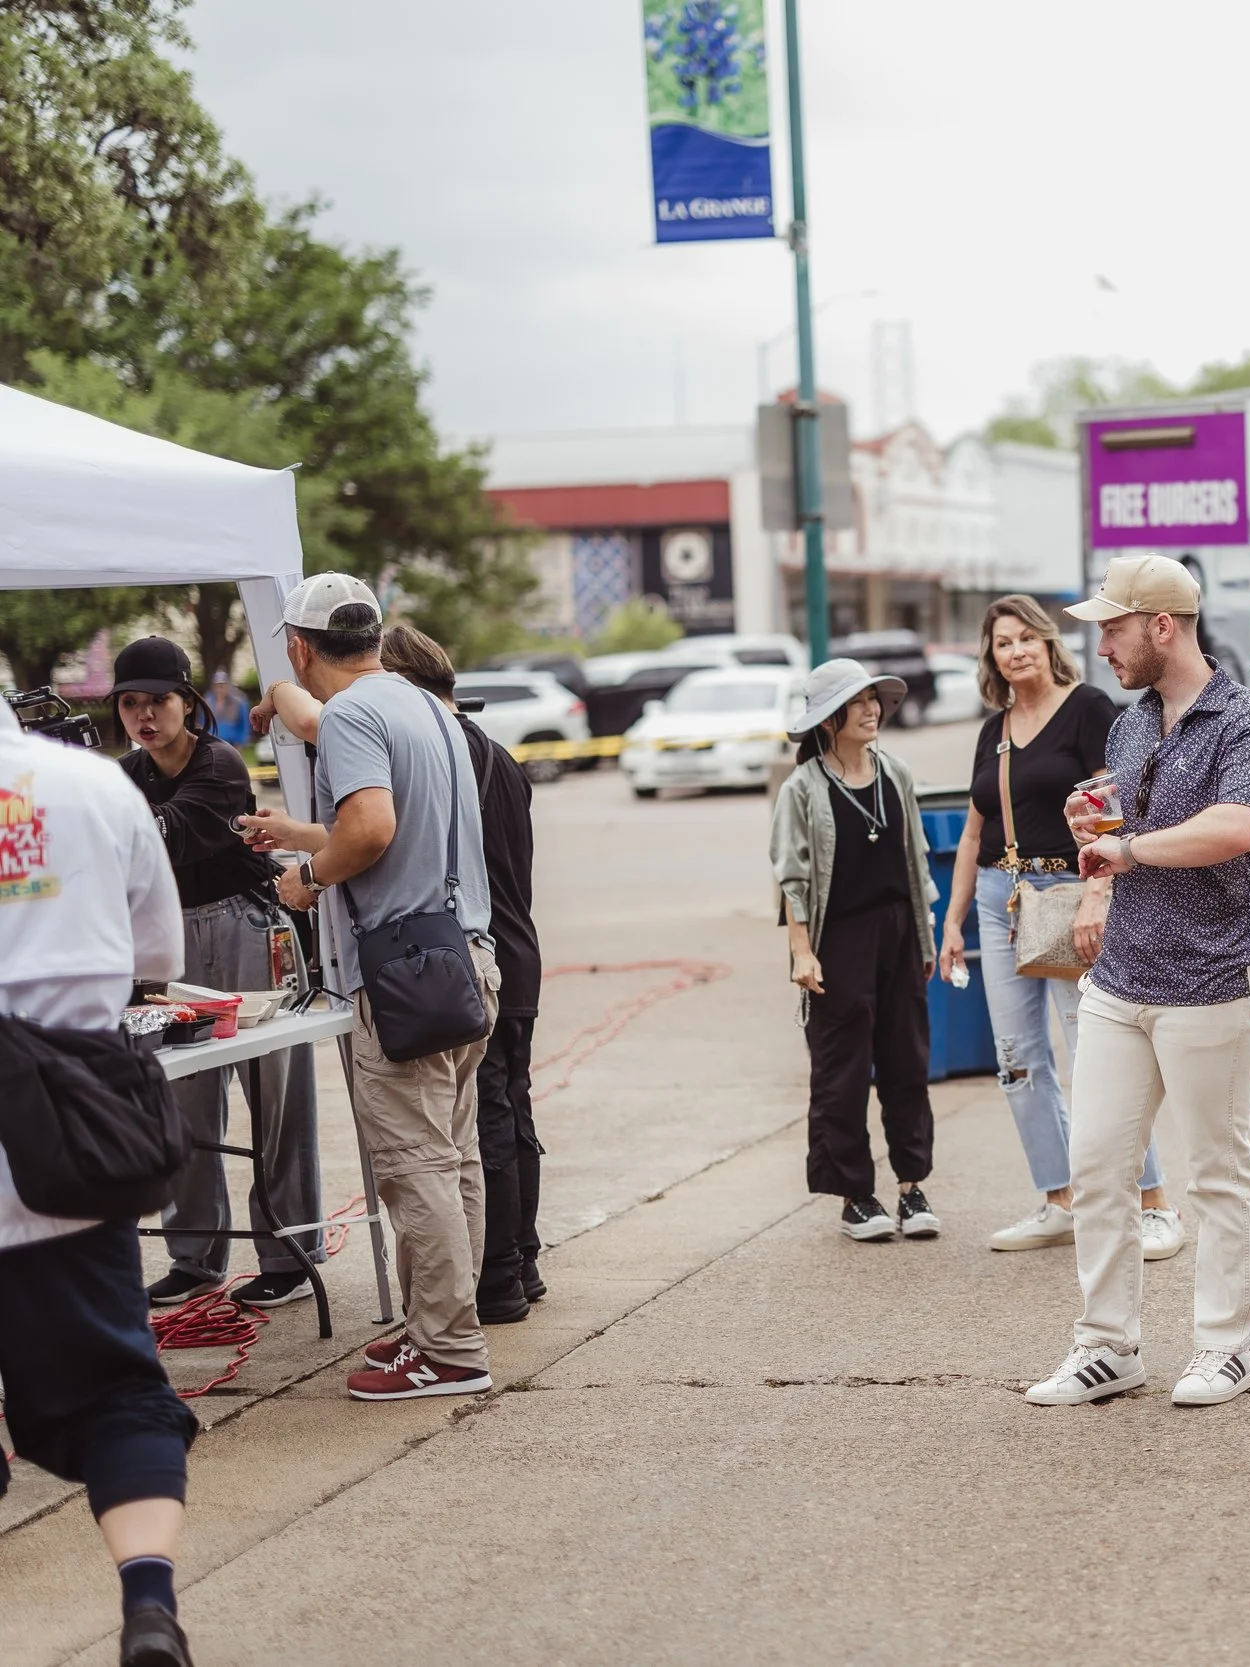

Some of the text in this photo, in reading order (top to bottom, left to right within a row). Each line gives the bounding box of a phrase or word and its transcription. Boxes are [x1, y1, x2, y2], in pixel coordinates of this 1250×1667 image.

[658, 199, 689, 221] LA
[1100, 479, 1239, 527] FREE BURGERS
